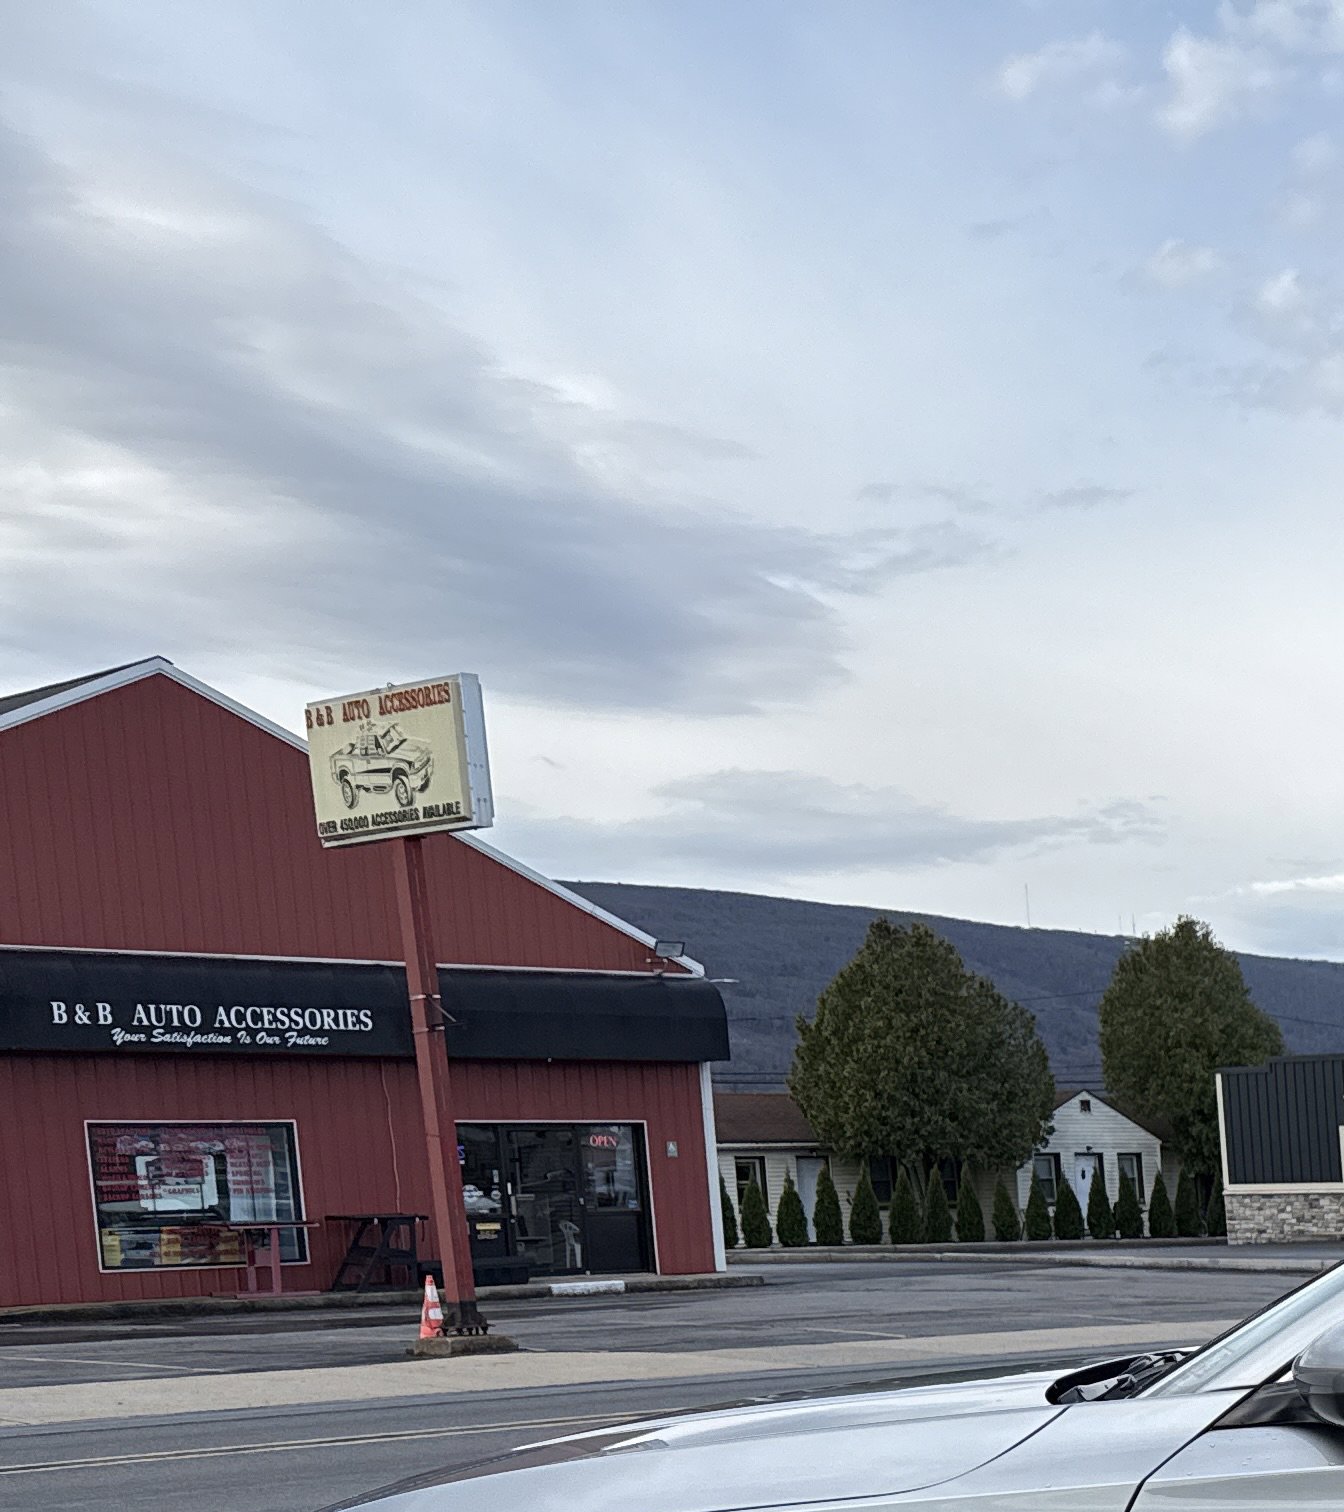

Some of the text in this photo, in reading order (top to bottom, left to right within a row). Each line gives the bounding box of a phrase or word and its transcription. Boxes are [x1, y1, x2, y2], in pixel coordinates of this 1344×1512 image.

[305, 682, 451, 729] B & B AUTO ACCESSORIES
[319, 819, 338, 836] OVER
[371, 807, 420, 828] ACCESSORIES
[423, 801, 461, 819] AVAILABLE
[51, 1001, 373, 1031] B & B AUTO ACCESSORIES
[111, 1027, 329, 1047] Your Satisfaction Is Our Future
[589, 1134, 617, 1147] OPEN
